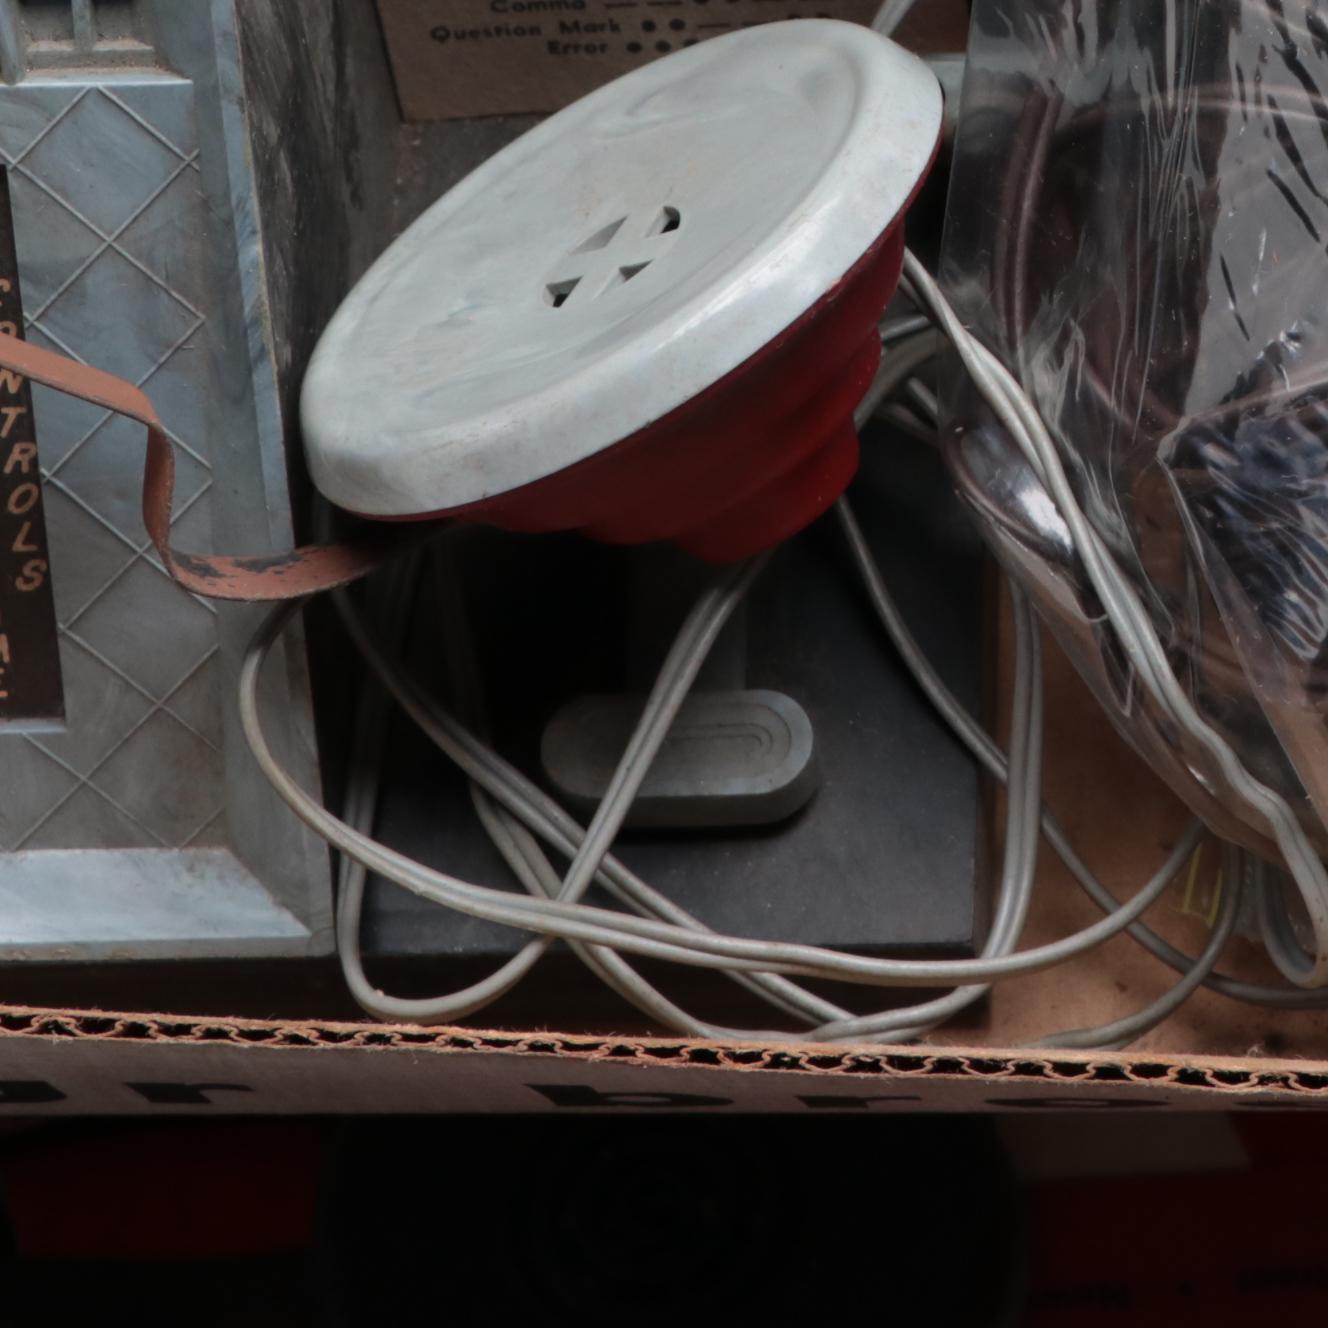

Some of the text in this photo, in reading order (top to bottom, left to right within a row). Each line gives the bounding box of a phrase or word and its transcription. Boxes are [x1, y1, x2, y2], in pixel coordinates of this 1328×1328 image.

[429, 18, 620, 44] Question Mark
[547, 40, 608, 56] Error
